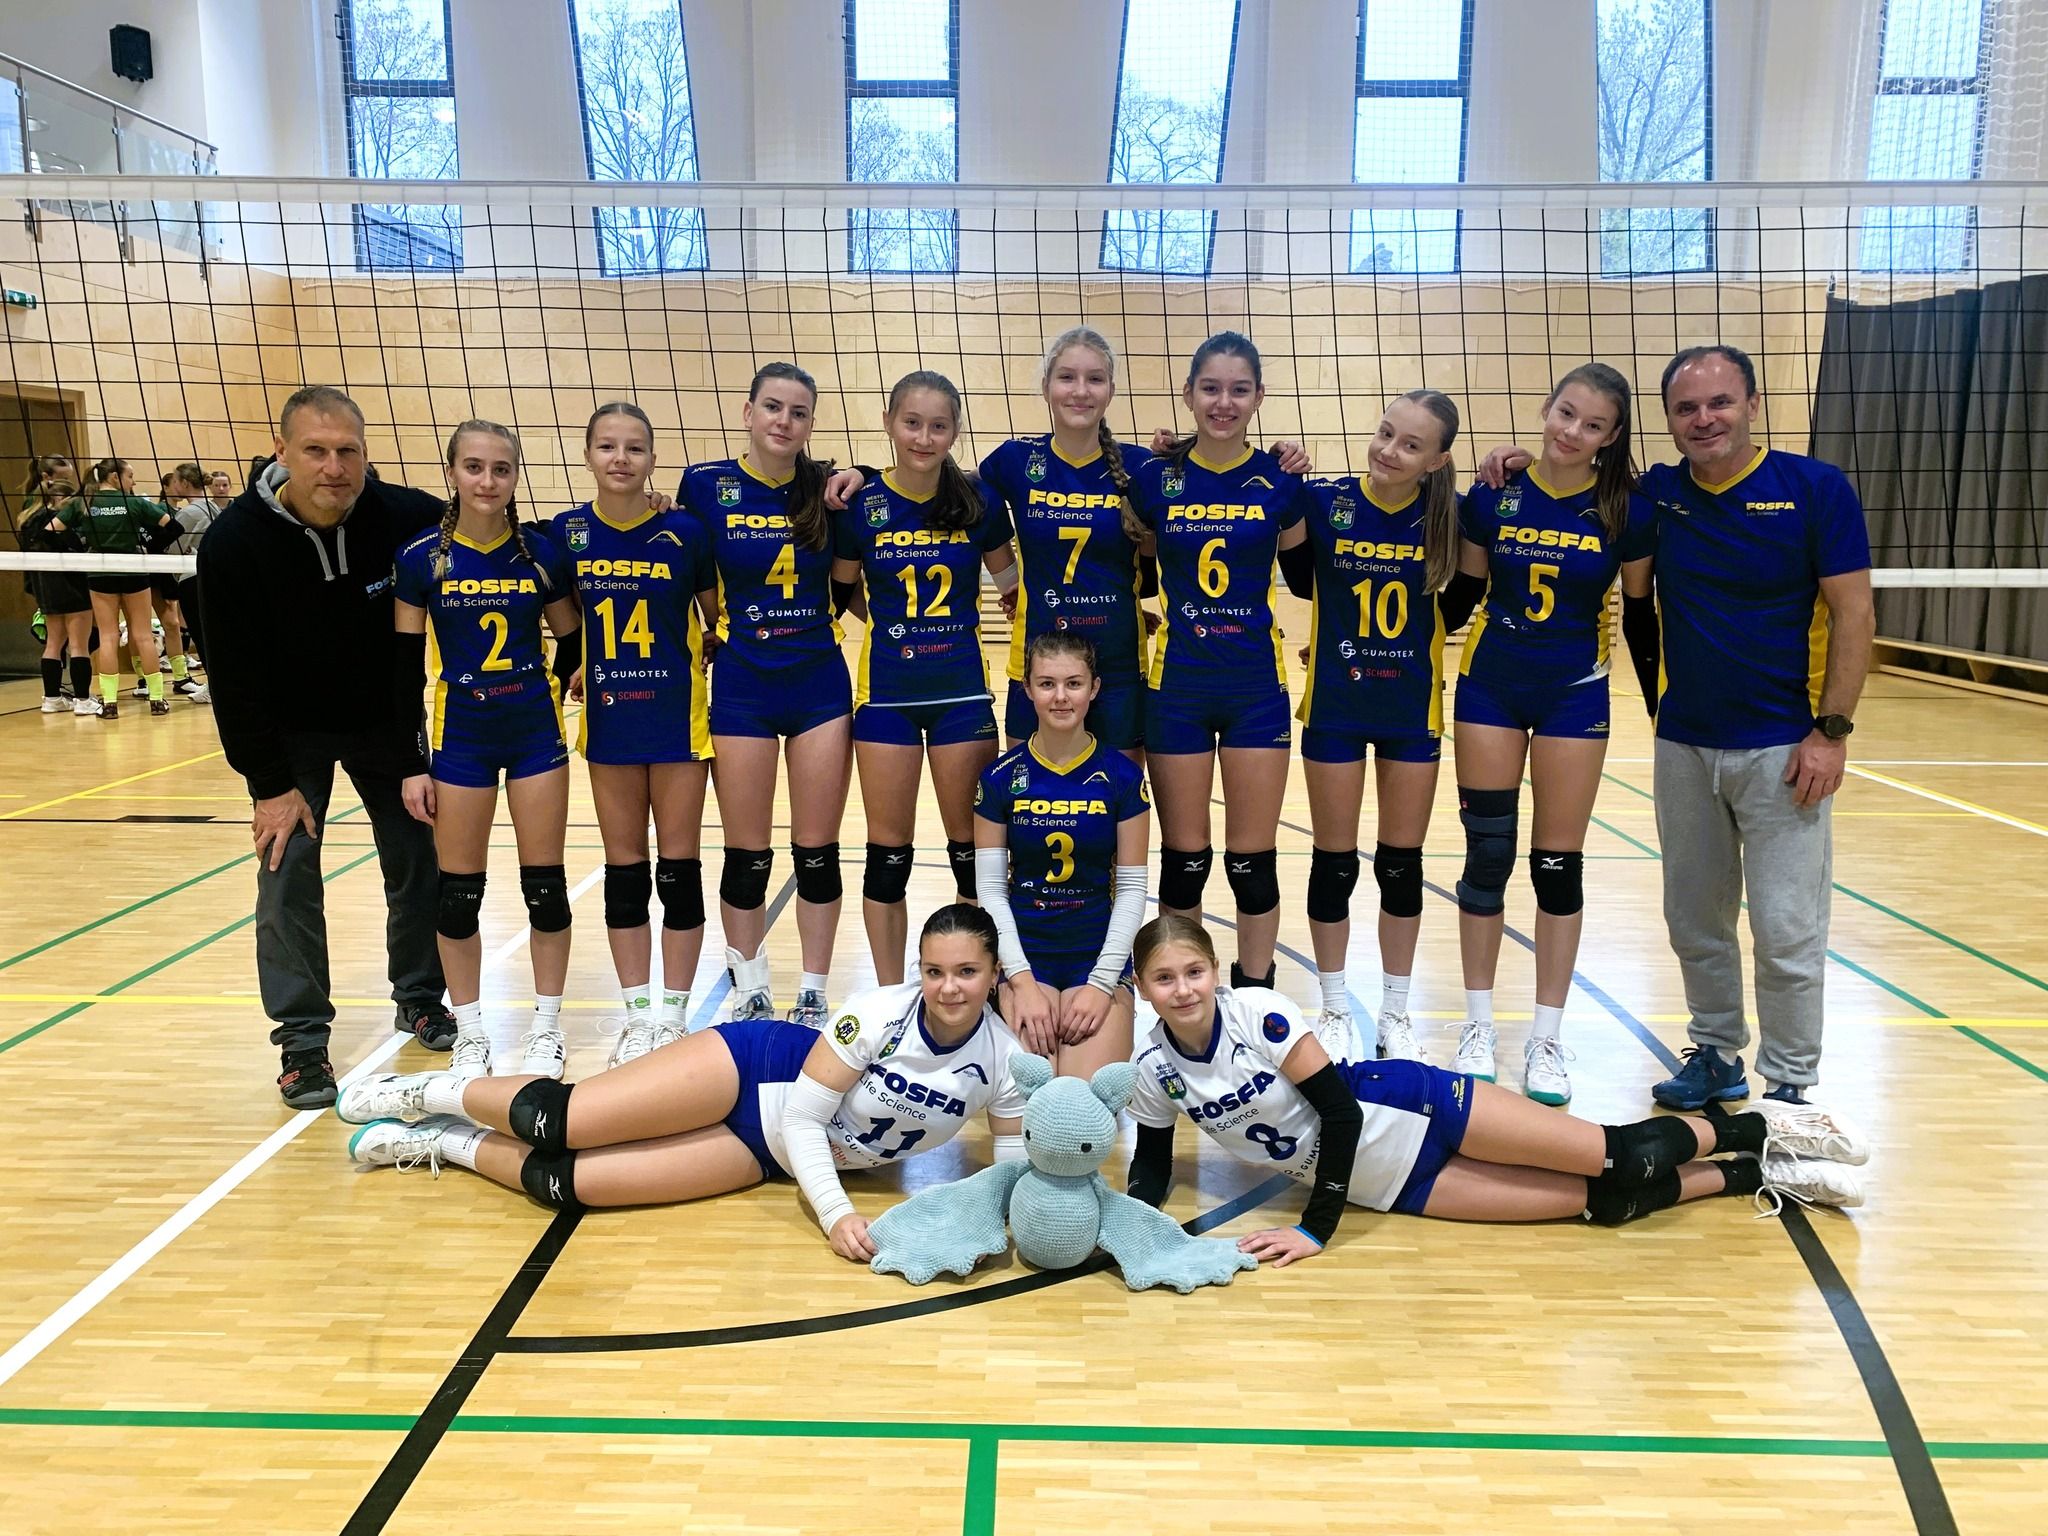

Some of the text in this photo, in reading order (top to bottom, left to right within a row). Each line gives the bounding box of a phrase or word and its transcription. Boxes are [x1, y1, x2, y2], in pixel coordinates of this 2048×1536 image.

[1028, 489, 1122, 509] FOSFA
[1746, 501, 1796, 511] FOSFA
[726, 513, 795, 529] FOS
[1027, 508, 1094, 521] Life Science
[1167, 504, 1266, 521] FOSFA
[727, 530, 748, 540] Life
[1165, 523, 1234, 534] Life Science
[875, 529, 971, 547] FOSFA
[1498, 525, 1602, 553] FOSFA
[875, 549, 941, 560] Life Science
[1058, 526, 1092, 584] 7
[1494, 544, 1565, 561] Life Science
[576, 559, 672, 580] FOSFA
[765, 543, 799, 599] 4
[1197, 537, 1230, 598] 6
[1334, 558, 1401, 574] Life Science
[441, 579, 538, 595] FOSFA
[594, 580, 640, 591] Science
[896, 563, 953, 618] 12
[1525, 562, 1560, 622] 5
[441, 597, 510, 608] Life Science
[1064, 594, 1117, 604] GUMOTEX
[767, 608, 817, 618] GUMOTEX
[1202, 606, 1252, 616] GUMOTEX
[1352, 577, 1408, 639] 10
[594, 597, 655, 660] 14
[911, 623, 965, 633] GUMOTEX
[1071, 615, 1108, 625] SCHMIDT
[478, 611, 513, 672] 2
[1361, 648, 1415, 658] GUMOTEX
[610, 669, 669, 679] GUMOTEX
[617, 691, 656, 700] SCHMIDT
[1013, 799, 1108, 816] FOSFA
[1012, 816, 1078, 828] Life Science
[1044, 831, 1076, 884] 3
[1186, 1070, 1277, 1124] FOSFA
[877, 1091, 928, 1122] Science
[1215, 1106, 1260, 1133] Science
[854, 1116, 927, 1160] 11
[1245, 1122, 1298, 1161] 8
